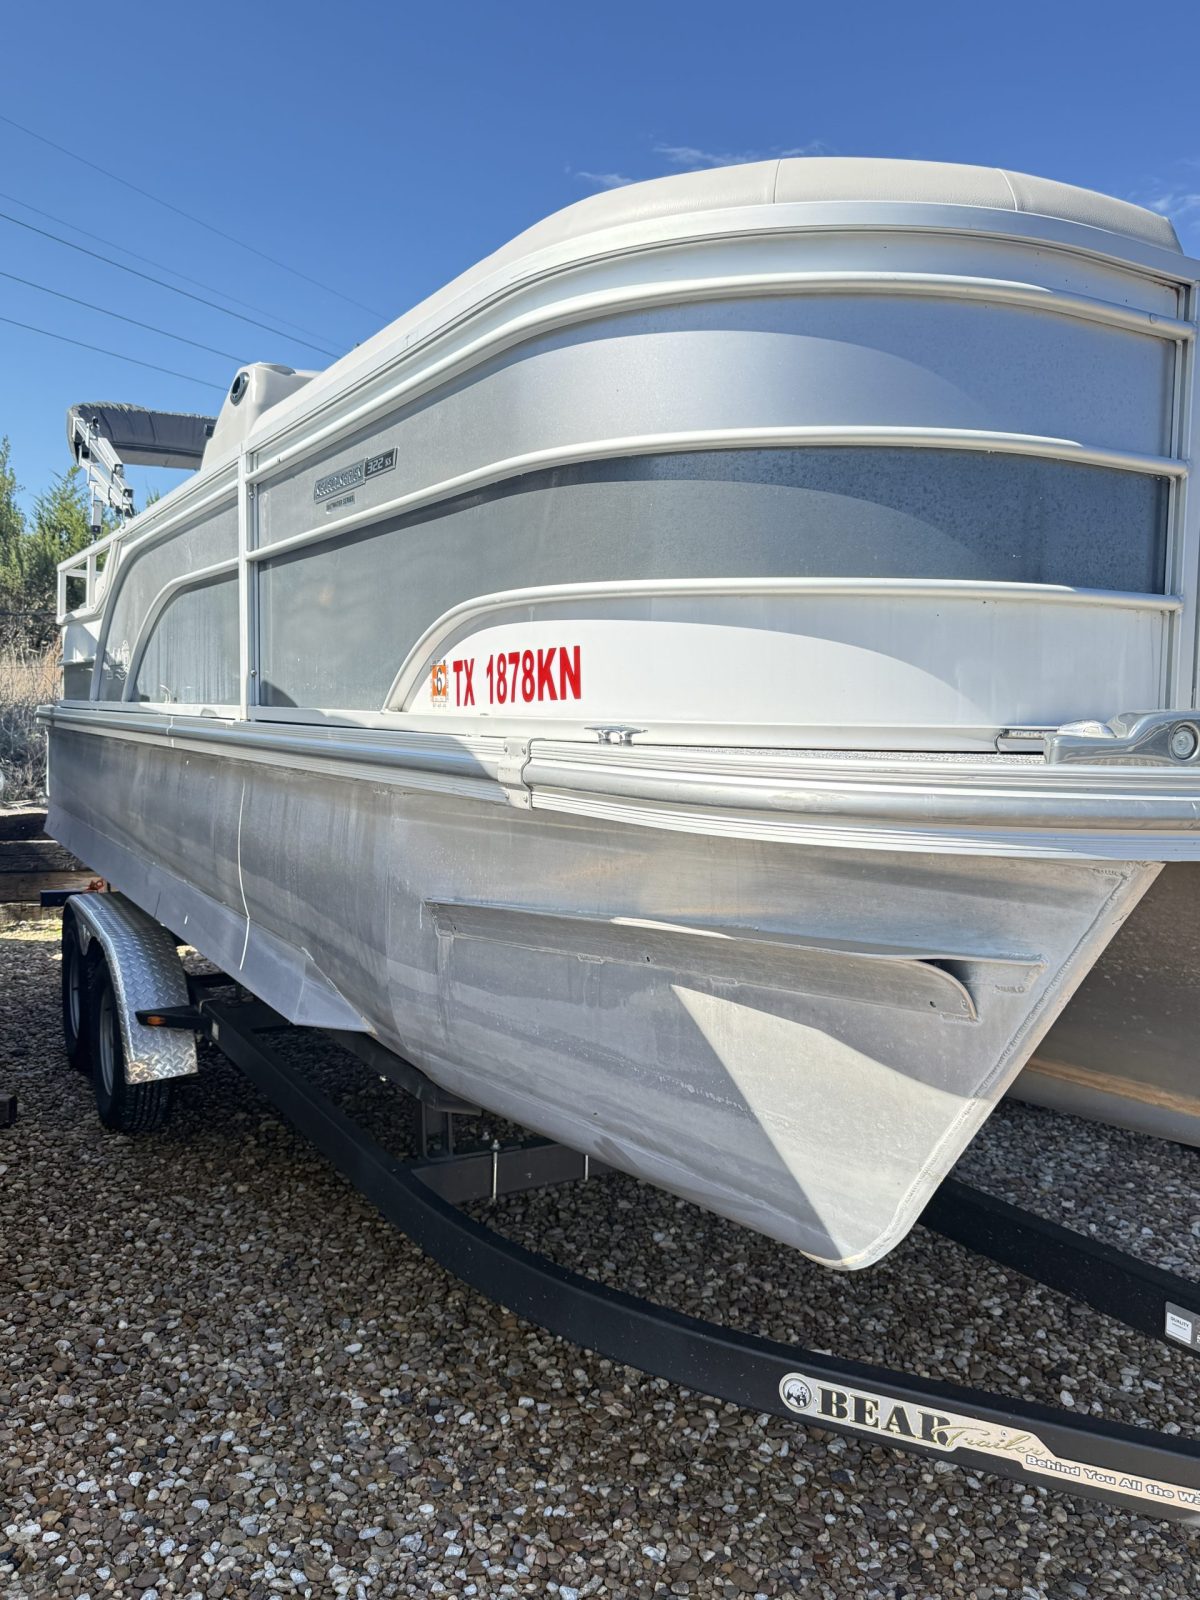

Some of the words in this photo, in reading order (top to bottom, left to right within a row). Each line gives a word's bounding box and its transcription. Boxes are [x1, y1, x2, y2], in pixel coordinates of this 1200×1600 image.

[367, 457, 383, 474] 322
[452, 658, 475, 707] TX
[486, 645, 581, 705] 1878KN
[1170, 1316, 1189, 1327] QUALITY
[817, 1386, 951, 1447] BEAR
[1026, 1455, 1081, 1476] Behind
[1083, 1467, 1116, 1485] You
[1119, 1477, 1142, 1491] All
[1145, 1483, 1174, 1499] the
